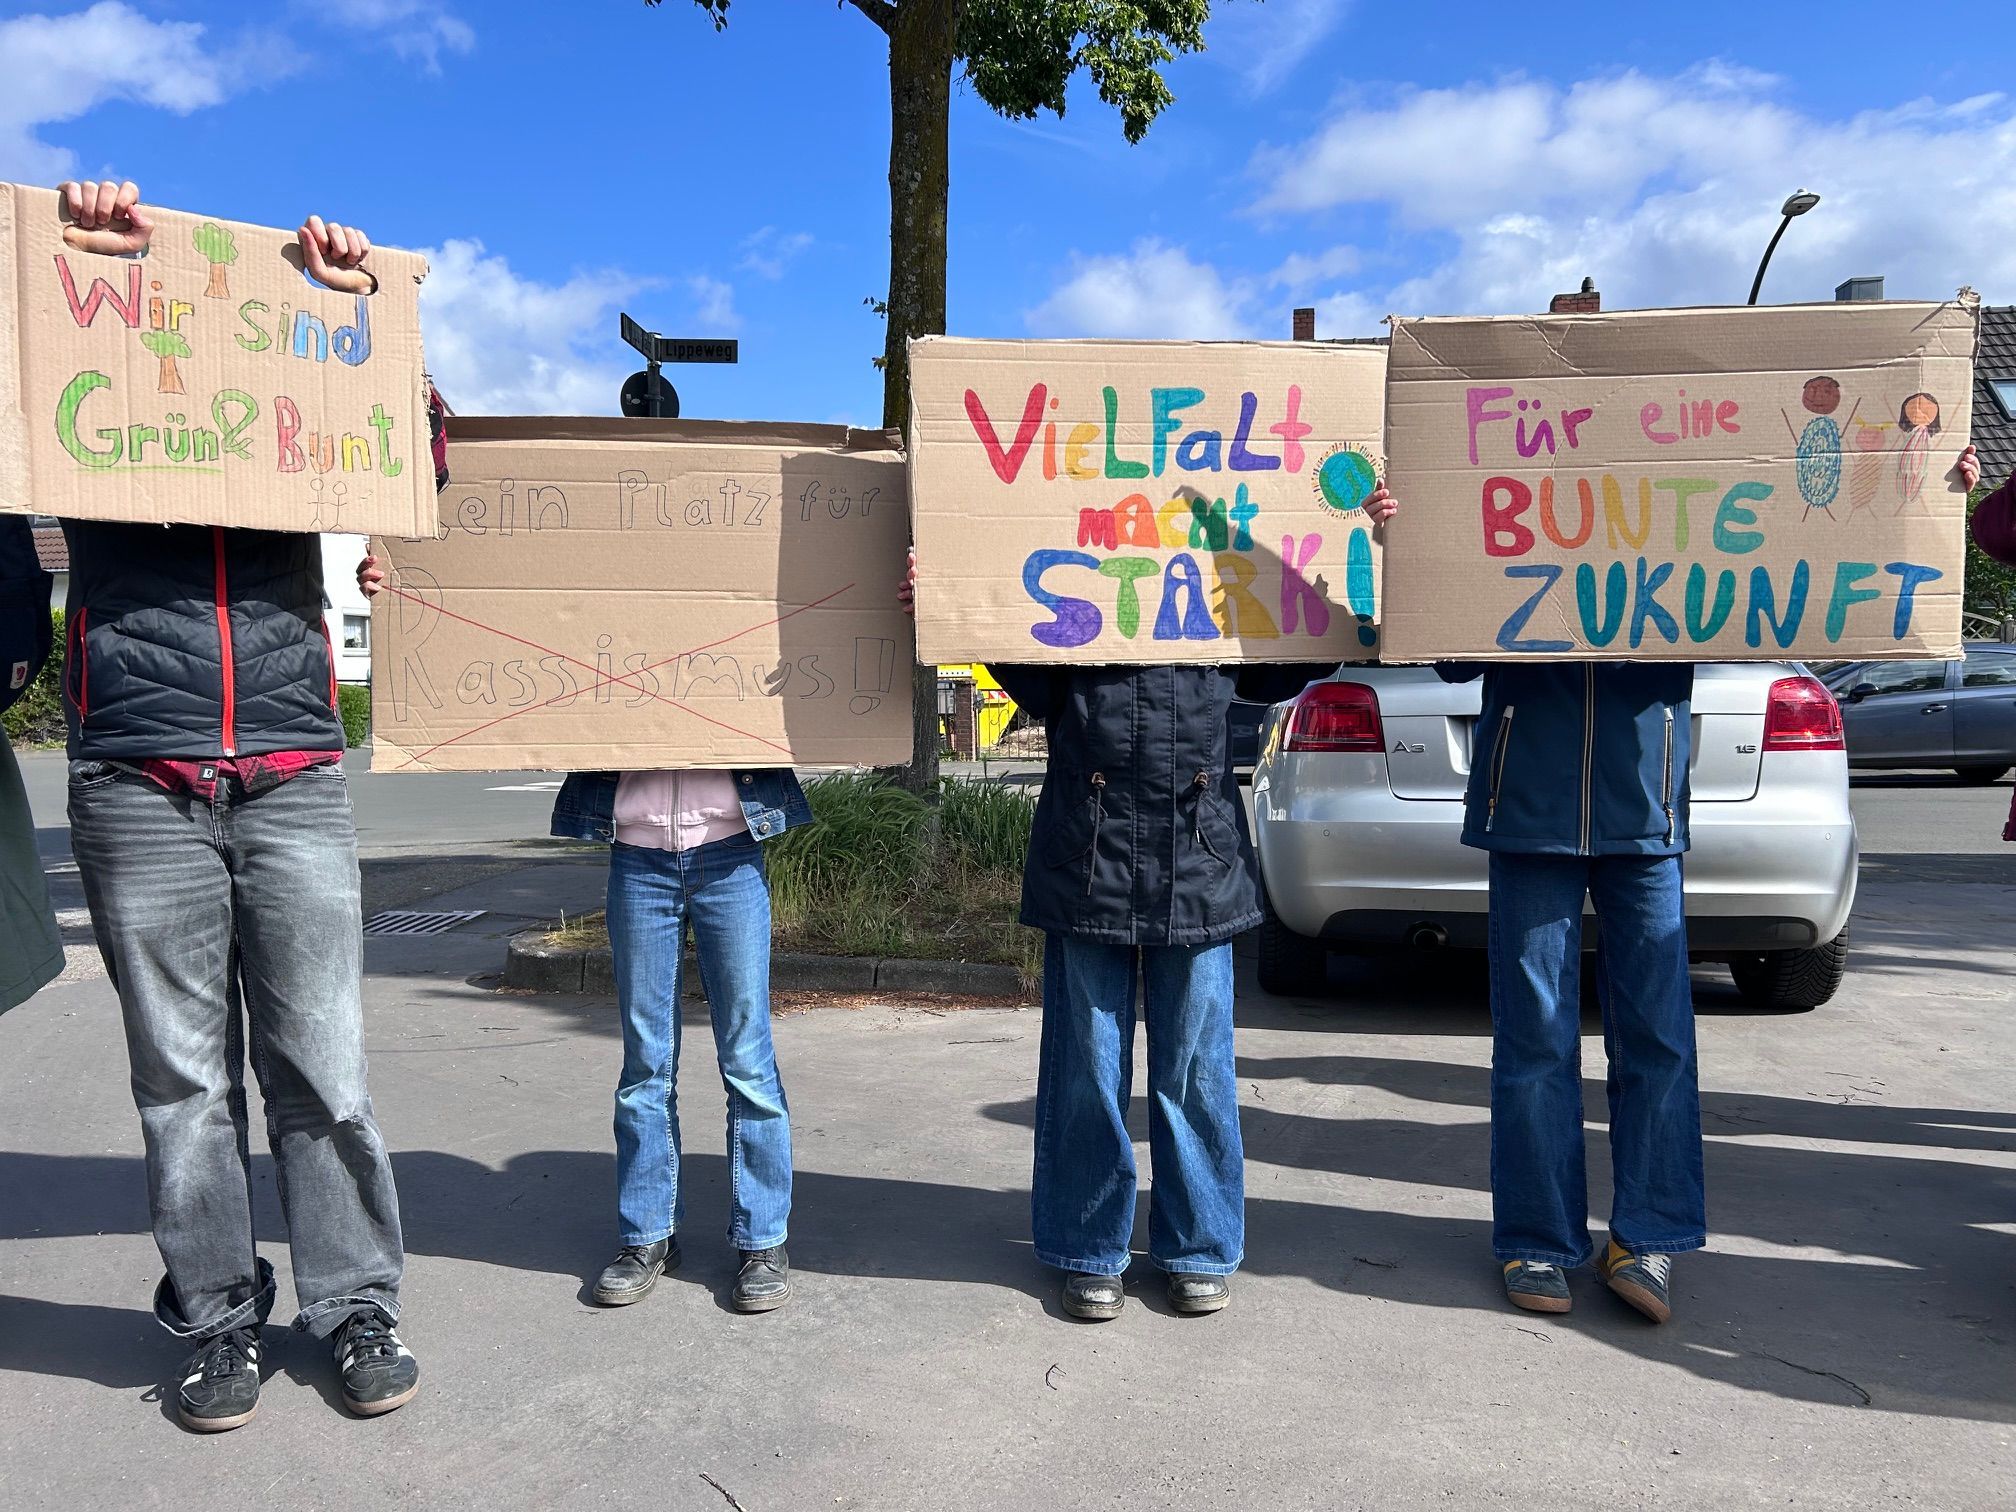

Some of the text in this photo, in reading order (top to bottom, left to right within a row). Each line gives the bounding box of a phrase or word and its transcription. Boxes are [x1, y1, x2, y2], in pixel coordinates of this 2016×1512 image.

[53, 254, 372, 367] Wir sind
[665, 341, 733, 361] Lippeweg
[273, 395, 404, 477] Bunt
[1466, 386, 1741, 465] Für eine
[401, 469, 881, 543] ein Platz für
[1481, 474, 1776, 558] BUNTE
[1022, 526, 1377, 648] STARK!
[1495, 556, 1944, 653] ZUKUNFT
[1391, 740, 1426, 754] A3
